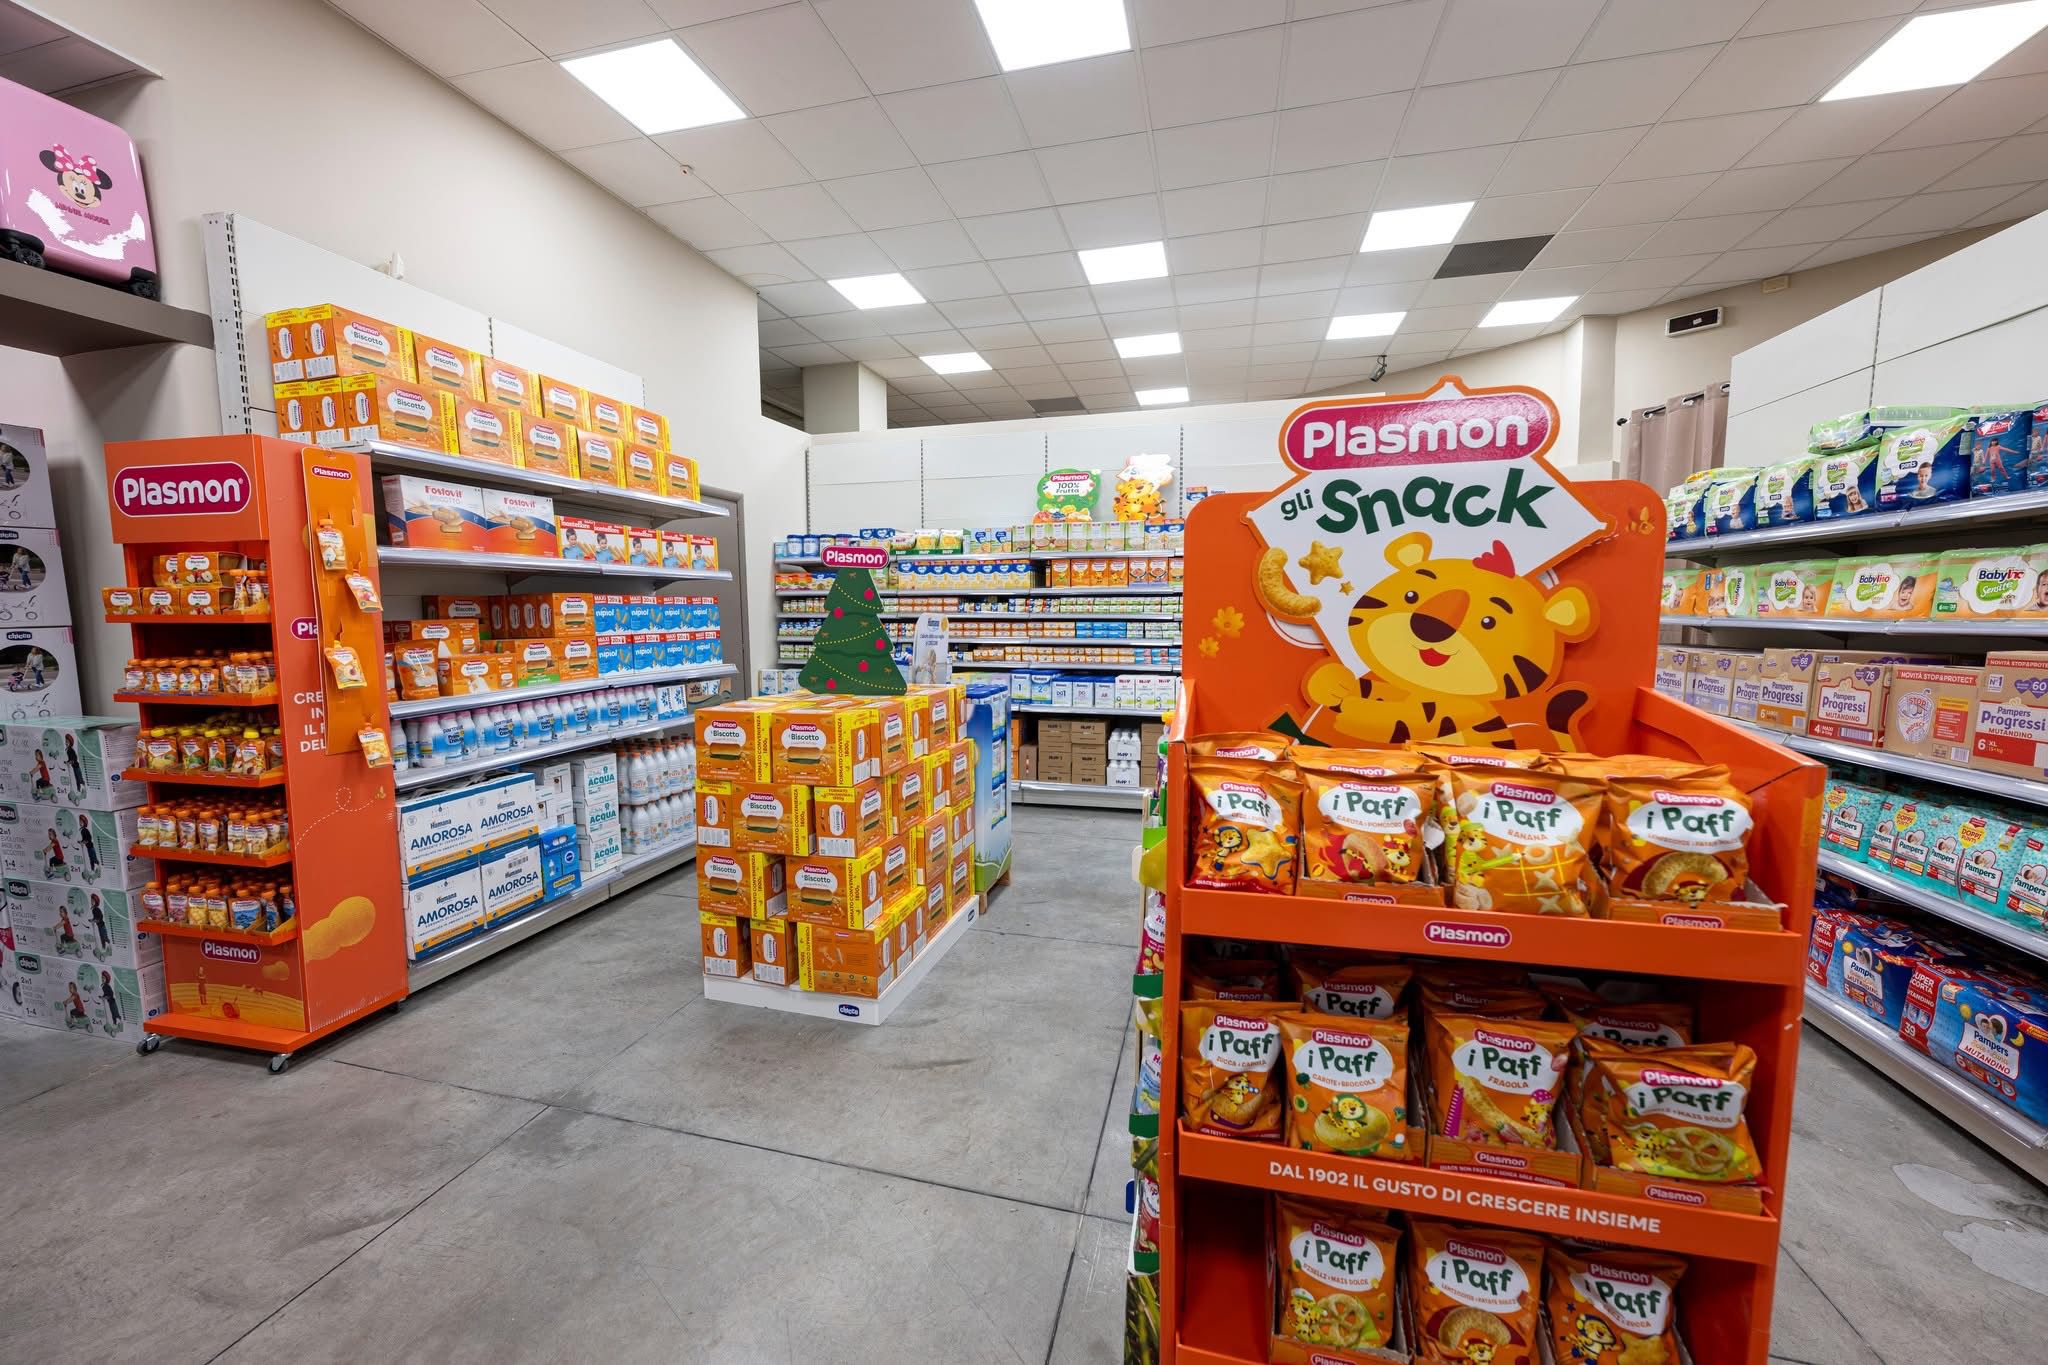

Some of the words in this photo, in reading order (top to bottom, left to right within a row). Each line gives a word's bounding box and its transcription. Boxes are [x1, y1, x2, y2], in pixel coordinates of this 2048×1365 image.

[353, 331, 384, 346] Biscotto
[396, 398, 426, 411] Biscotto
[1303, 411, 1530, 459] Plasmon
[313, 466, 351, 480] Plasmon
[122, 477, 241, 507] Plasmon
[1281, 489, 1314, 521] gli
[1315, 468, 1556, 535] Snack
[825, 552, 883, 564] Plasmon
[1800, 656, 1809, 665] 68
[1657, 674, 1682, 688] Progressi
[1866, 670, 1875, 679] 76
[1923, 673, 1974, 684] STOP&PROTECT
[1697, 680, 1726, 694] Progressi
[1771, 681, 1794, 692] Pampers
[2032, 681, 2047, 690] 60
[1736, 686, 1759, 701] Progre
[1761, 686, 1804, 705] Progressi
[1833, 692, 1856, 702] Pampers
[1822, 696, 1866, 713] Progressi
[1997, 706, 2031, 718] Pampers
[1759, 708, 1765, 719] 6
[1825, 711, 1860, 722] MUTANDINO
[1981, 710, 2047, 731] Progressi
[712, 721, 737, 729] Plasmon
[791, 724, 817, 732] Plasmon
[1814, 724, 1820, 734] 4
[713, 730, 740, 738] Biscotto
[791, 733, 820, 741] Biscotto
[1988, 727, 2033, 739] MUTANDINO
[1977, 739, 1986, 750] 6
[588, 773, 615, 787] ACQUA
[1342, 783, 1398, 793] Plasmon
[1494, 783, 1554, 803] Plasmon
[749, 793, 774, 801] Plasmon
[1656, 792, 1722, 804] Plasmon
[750, 802, 777, 810] Biscotto
[1217, 796, 1222, 808] i
[1227, 793, 1271, 817] Paff
[1333, 795, 1340, 811] i
[1348, 792, 1409, 819] Paff
[480, 804, 534, 829] AMOROSA
[589, 809, 617, 824] ACQUA
[1483, 803, 1490, 819] i
[1497, 800, 1562, 831] Paff
[1647, 811, 1654, 829] i
[1662, 807, 1736, 838] Paff
[1834, 817, 1857, 831] Pampers
[410, 823, 473, 850] AMOROSA
[1507, 829, 1549, 842] BANANA
[594, 844, 620, 860] ACQUA
[1899, 841, 1924, 856] Pampers
[712, 865, 737, 874] Biscotto
[1965, 861, 1996, 879] Pampers
[488, 871, 539, 900] AMOROSA
[804, 874, 831, 884] Biscotto
[2015, 876, 2047, 897] Pampers
[417, 895, 479, 928] AMOROSA
[1666, 916, 1721, 929] Plasmon
[1429, 925, 1505, 944] Plasmon
[205, 941, 257, 960] Plasmon
[1809, 961, 1819, 973] 42
[1315, 994, 1321, 1006] i
[1326, 993, 1382, 1018] Paff
[1216, 1015, 1267, 1030] Plasmon
[1904, 1022, 1916, 1037] 39
[1208, 1034, 1215, 1051] i
[1219, 1030, 1275, 1060] Paff
[1315, 1031, 1371, 1046] Plasmon
[1477, 1031, 1534, 1050] Plasmon
[1974, 1030, 2009, 1057] Pampers
[1308, 1050, 1314, 1068] i
[1319, 1046, 1379, 1077] Paff
[1467, 1049, 1476, 1067] i
[1482, 1047, 1542, 1080] Paff
[1956, 1055, 1966, 1068] 6
[1964, 1045, 2011, 1075] MUTANDINO
[1487, 1074, 1530, 1089] FRAGOLA
[1645, 1071, 1722, 1087] Plasmon
[1638, 1091, 1645, 1108] i
[1653, 1087, 1733, 1112] Paff
[1479, 1152, 1526, 1167] Plasmon
[1269, 1162, 1305, 1179] DAL
[1308, 1168, 1349, 1186] 1902
[1353, 1173, 1370, 1190] IL
[1373, 1177, 1438, 1201] GUSTO
[1441, 1187, 1461, 1203] DI
[1466, 1190, 1570, 1221] CRESCERE
[1575, 1206, 1661, 1234] INSIEME
[1650, 1188, 1702, 1204] Plasmon
[1313, 1222, 1364, 1245] Plasmon
[1302, 1240, 1310, 1258] i
[1315, 1239, 1372, 1275] Paff
[1449, 1241, 1504, 1264] Plasmon
[1440, 1260, 1448, 1280] i
[1454, 1258, 1514, 1296] Paff
[1590, 1263, 1650, 1284] Plasmon
[1595, 1281, 1662, 1319] Paff
